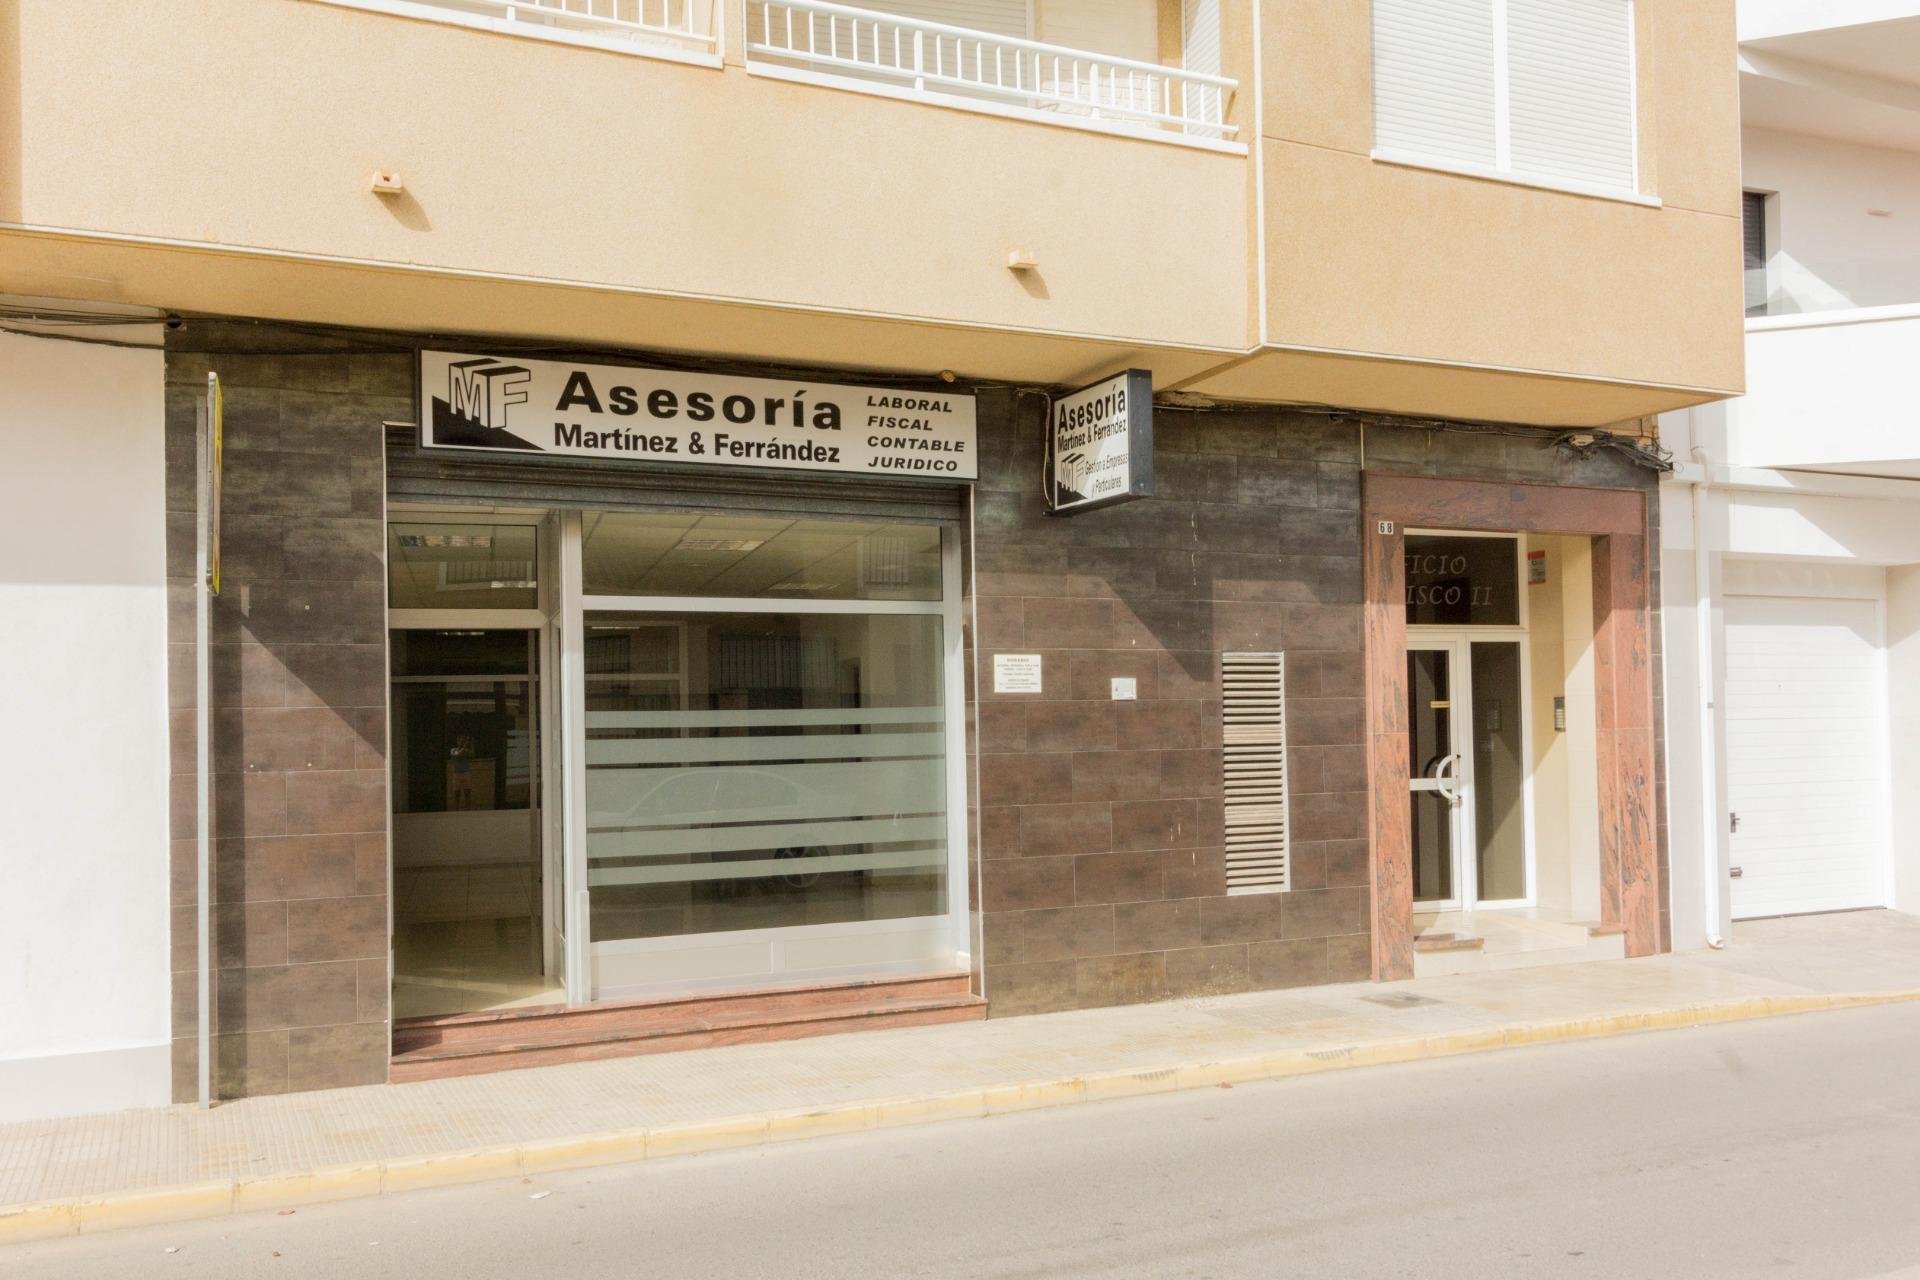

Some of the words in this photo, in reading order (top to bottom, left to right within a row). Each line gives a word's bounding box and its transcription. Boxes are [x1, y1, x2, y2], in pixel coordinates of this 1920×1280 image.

[449, 358, 531, 429] MF
[555, 371, 841, 430] Asesoría
[867, 395, 953, 413] LABORAL
[1058, 384, 1126, 434] Asesoría
[867, 416, 933, 431] FISCAL
[554, 422, 678, 453] Martínez
[688, 431, 705, 455] &
[714, 432, 840, 463] Ferrández
[867, 436, 965, 452] CONTABLE
[868, 456, 958, 471] JURIDICO
[1380, 522, 1393, 534] 68
[1406, 586, 1461, 605] ISCO
[1471, 586, 1493, 606] II
